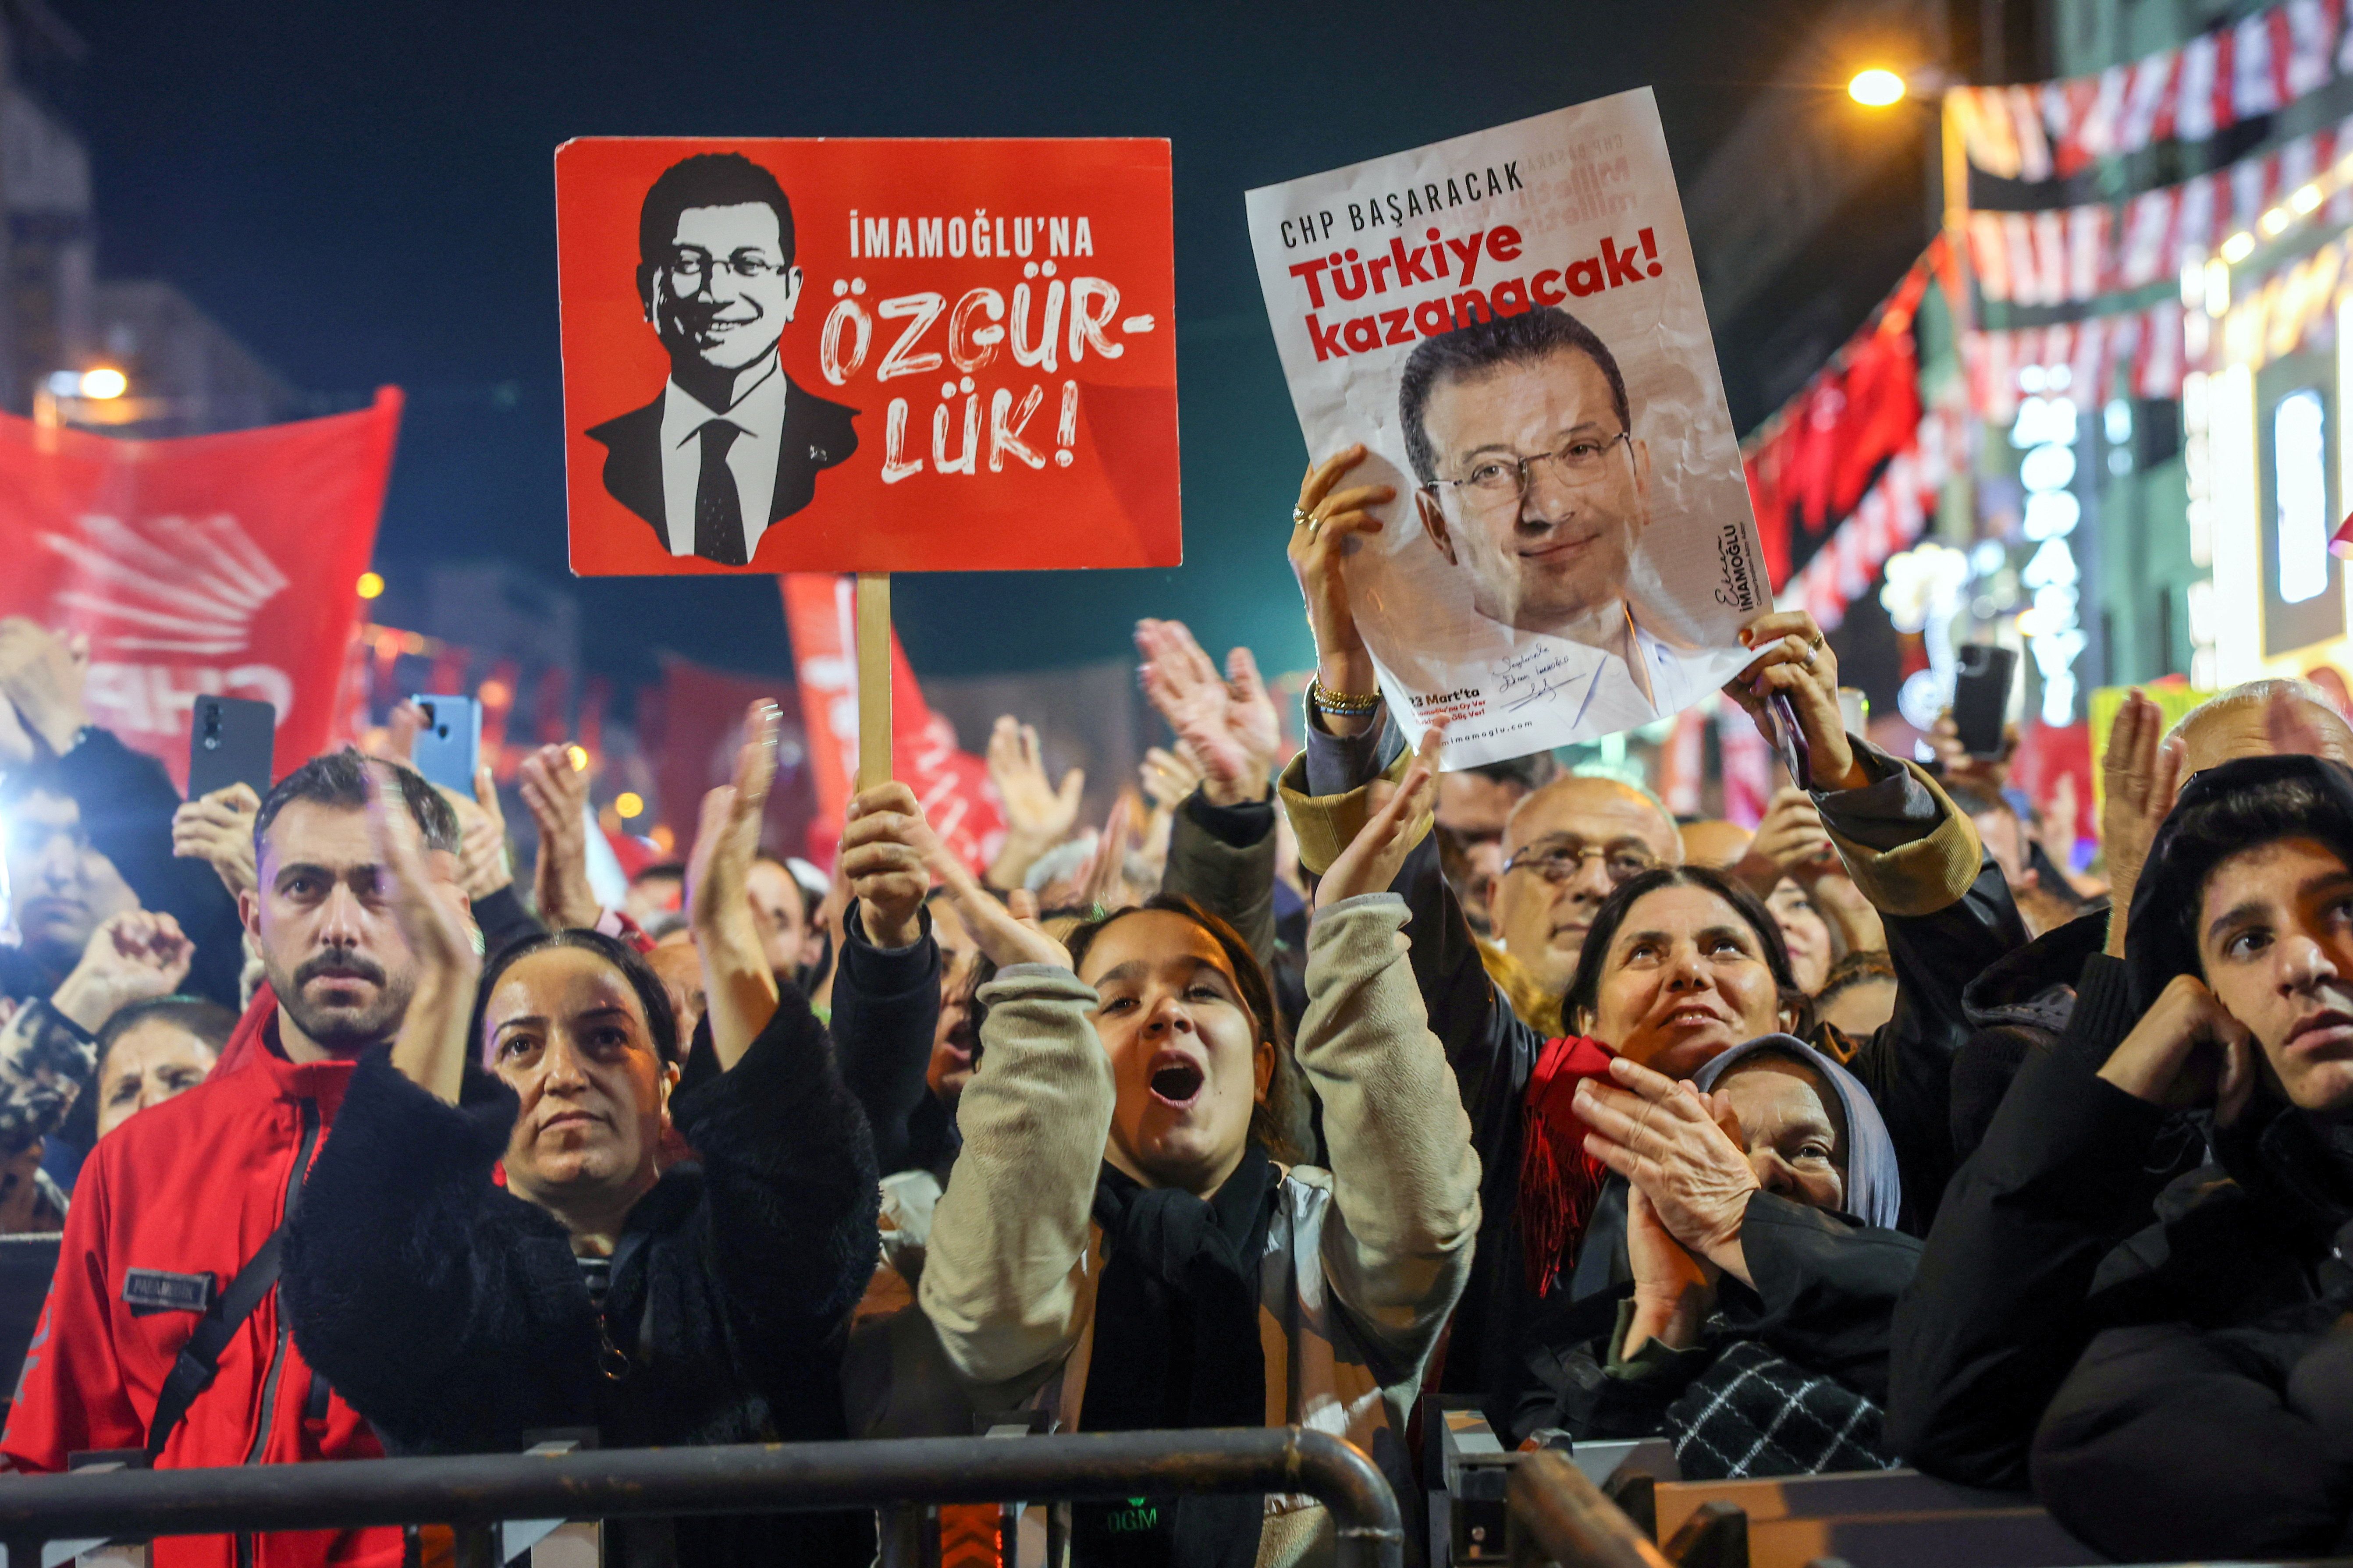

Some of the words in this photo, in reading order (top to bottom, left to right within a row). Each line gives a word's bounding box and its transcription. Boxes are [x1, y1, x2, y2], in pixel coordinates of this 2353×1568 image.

[849, 209, 1094, 258] İMAMOĞLU'NA
[1280, 210, 1334, 248] CHP
[1348, 161, 1524, 232] BAŞARACAK
[1288, 224, 1523, 309] Türkiye
[1304, 226, 1663, 362] kazanacak!
[821, 260, 1155, 386] ÖZGÜR-
[881, 376, 1078, 484] LÜK!
[1723, 524, 1753, 612] İMAMOĞLU
[1425, 688, 1480, 706] Mart'ta
